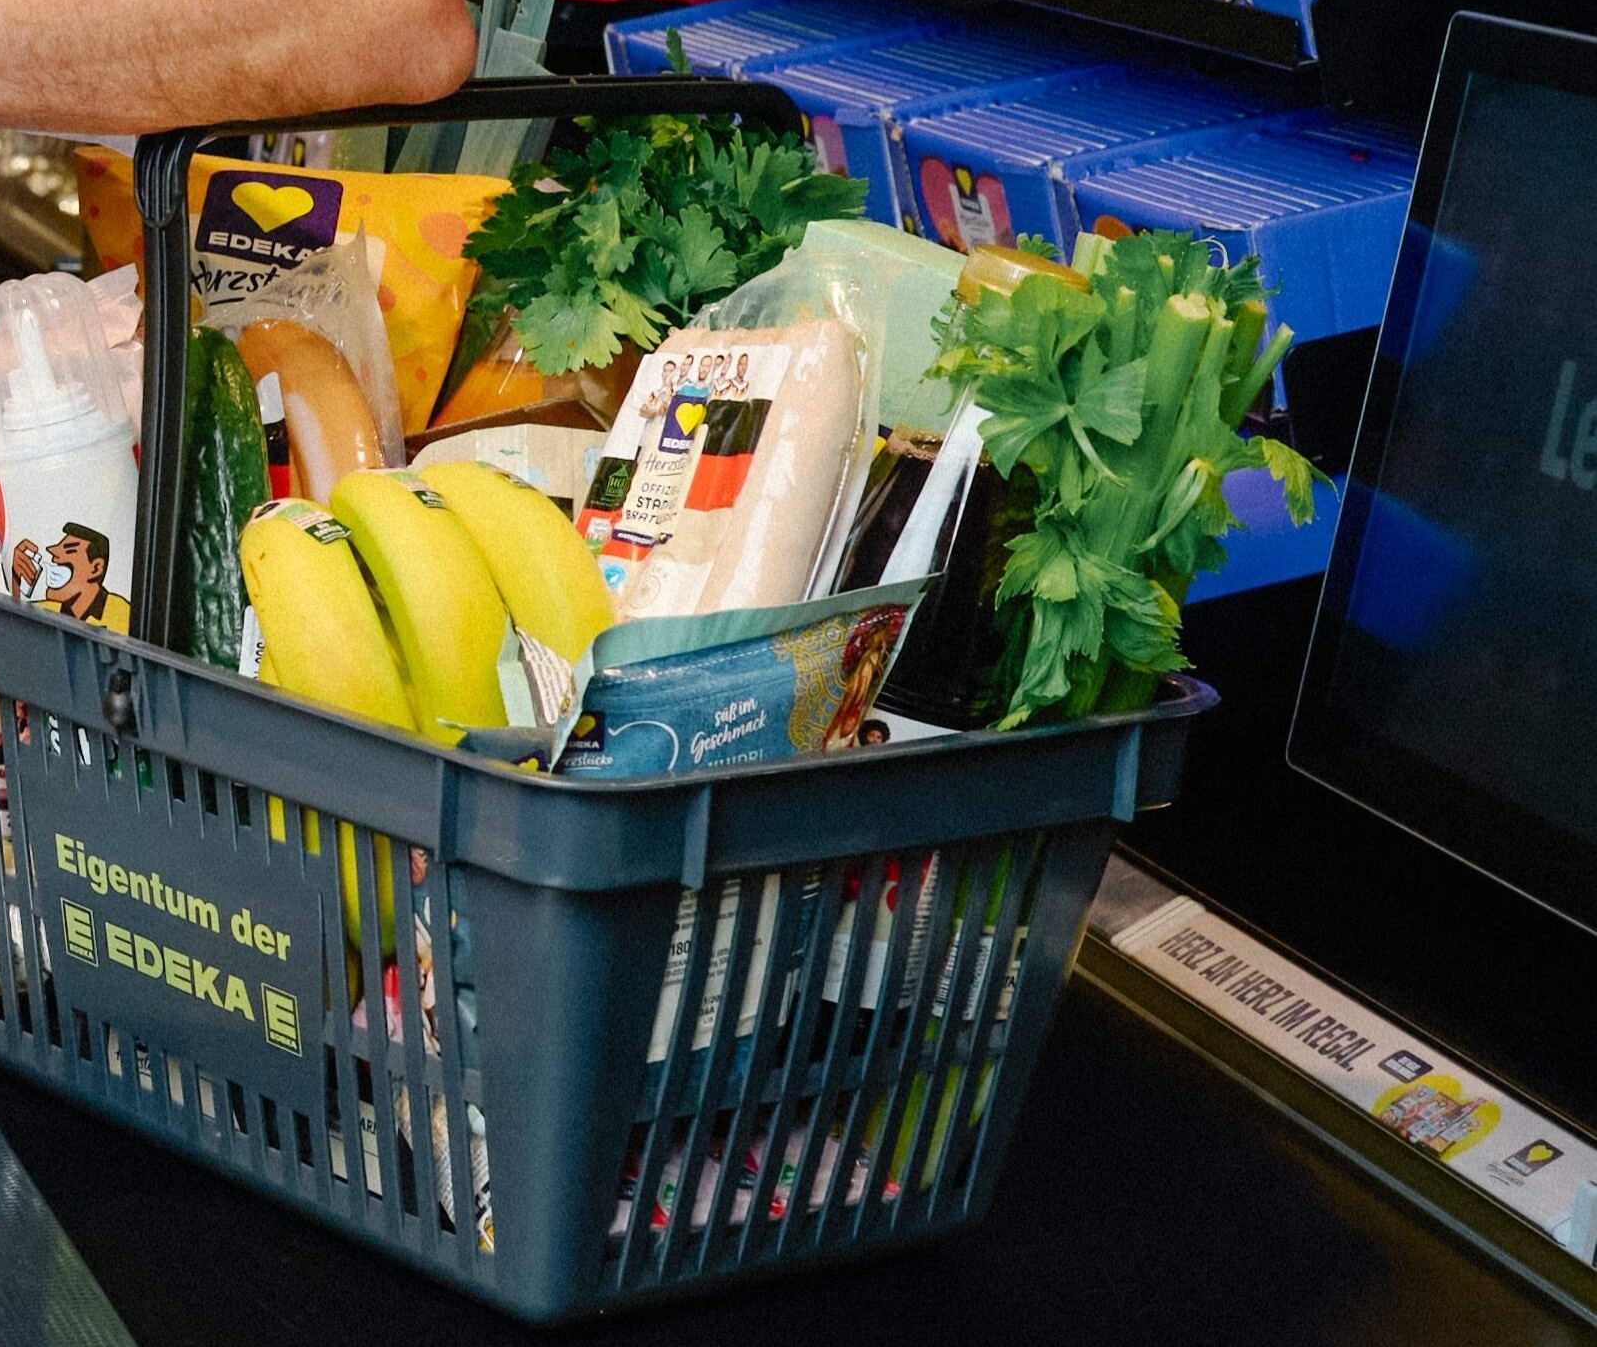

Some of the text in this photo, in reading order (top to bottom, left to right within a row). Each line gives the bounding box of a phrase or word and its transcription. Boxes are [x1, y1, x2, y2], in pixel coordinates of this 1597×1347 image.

[714, 697, 758, 728] süß im
[691, 710, 767, 764] Geschmack
[56, 833, 291, 961] Eigentum der
[1158, 927, 1225, 971] HERZ
[1199, 955, 1252, 987] AN
[105, 921, 255, 1022] EDEKA
[1224, 970, 1295, 1014] HERZ
[1269, 998, 1321, 1032] IM
[1296, 1015, 1376, 1072] REGAL.
